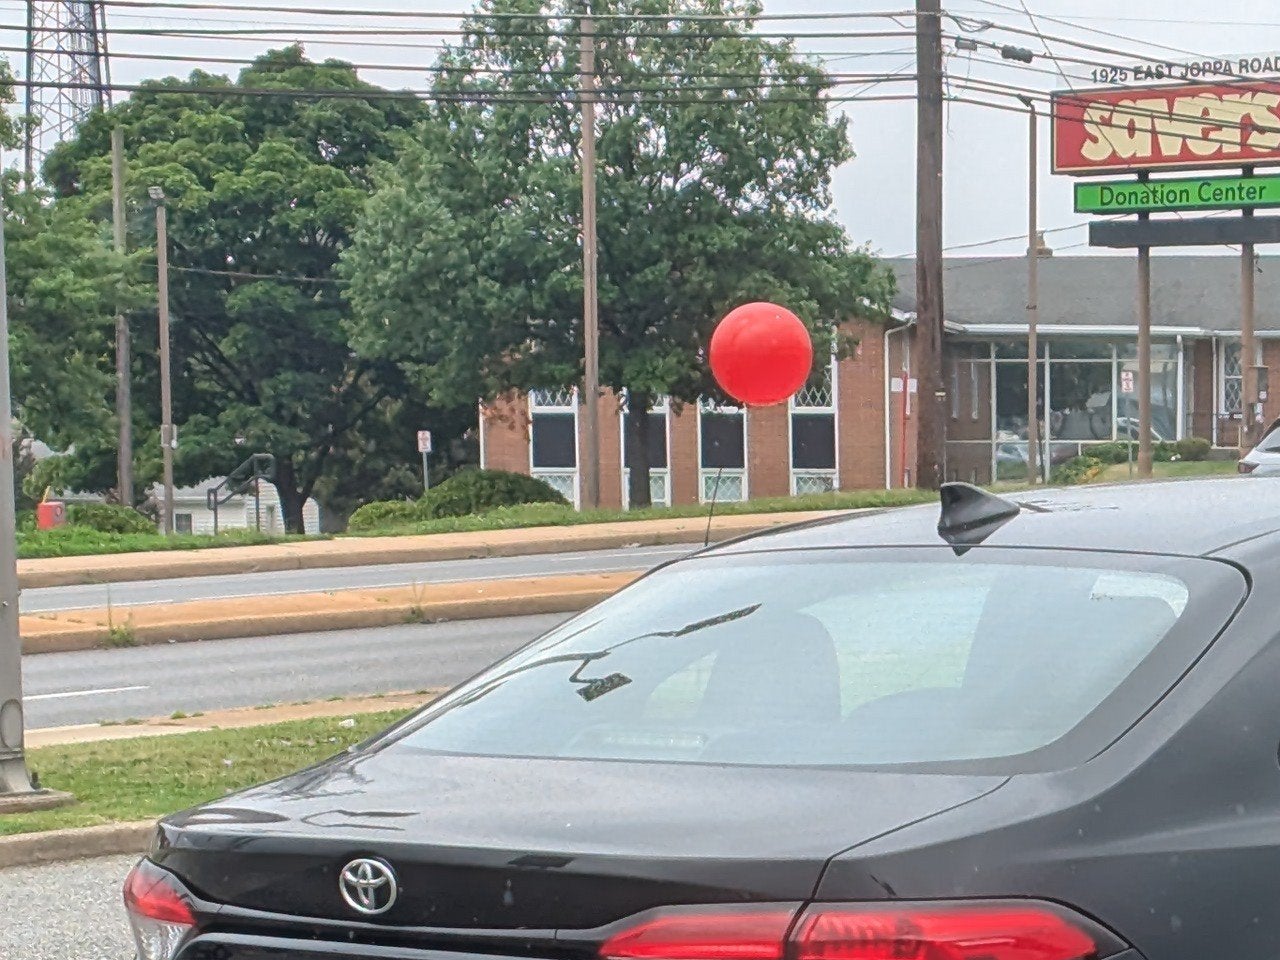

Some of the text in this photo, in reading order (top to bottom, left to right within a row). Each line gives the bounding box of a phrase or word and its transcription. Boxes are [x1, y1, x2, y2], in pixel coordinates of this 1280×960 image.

[1091, 67, 1128, 84] 1925
[1133, 63, 1174, 81] EAST
[1180, 59, 1234, 78] JOPPA
[1100, 183, 1267, 207] Donation Center
